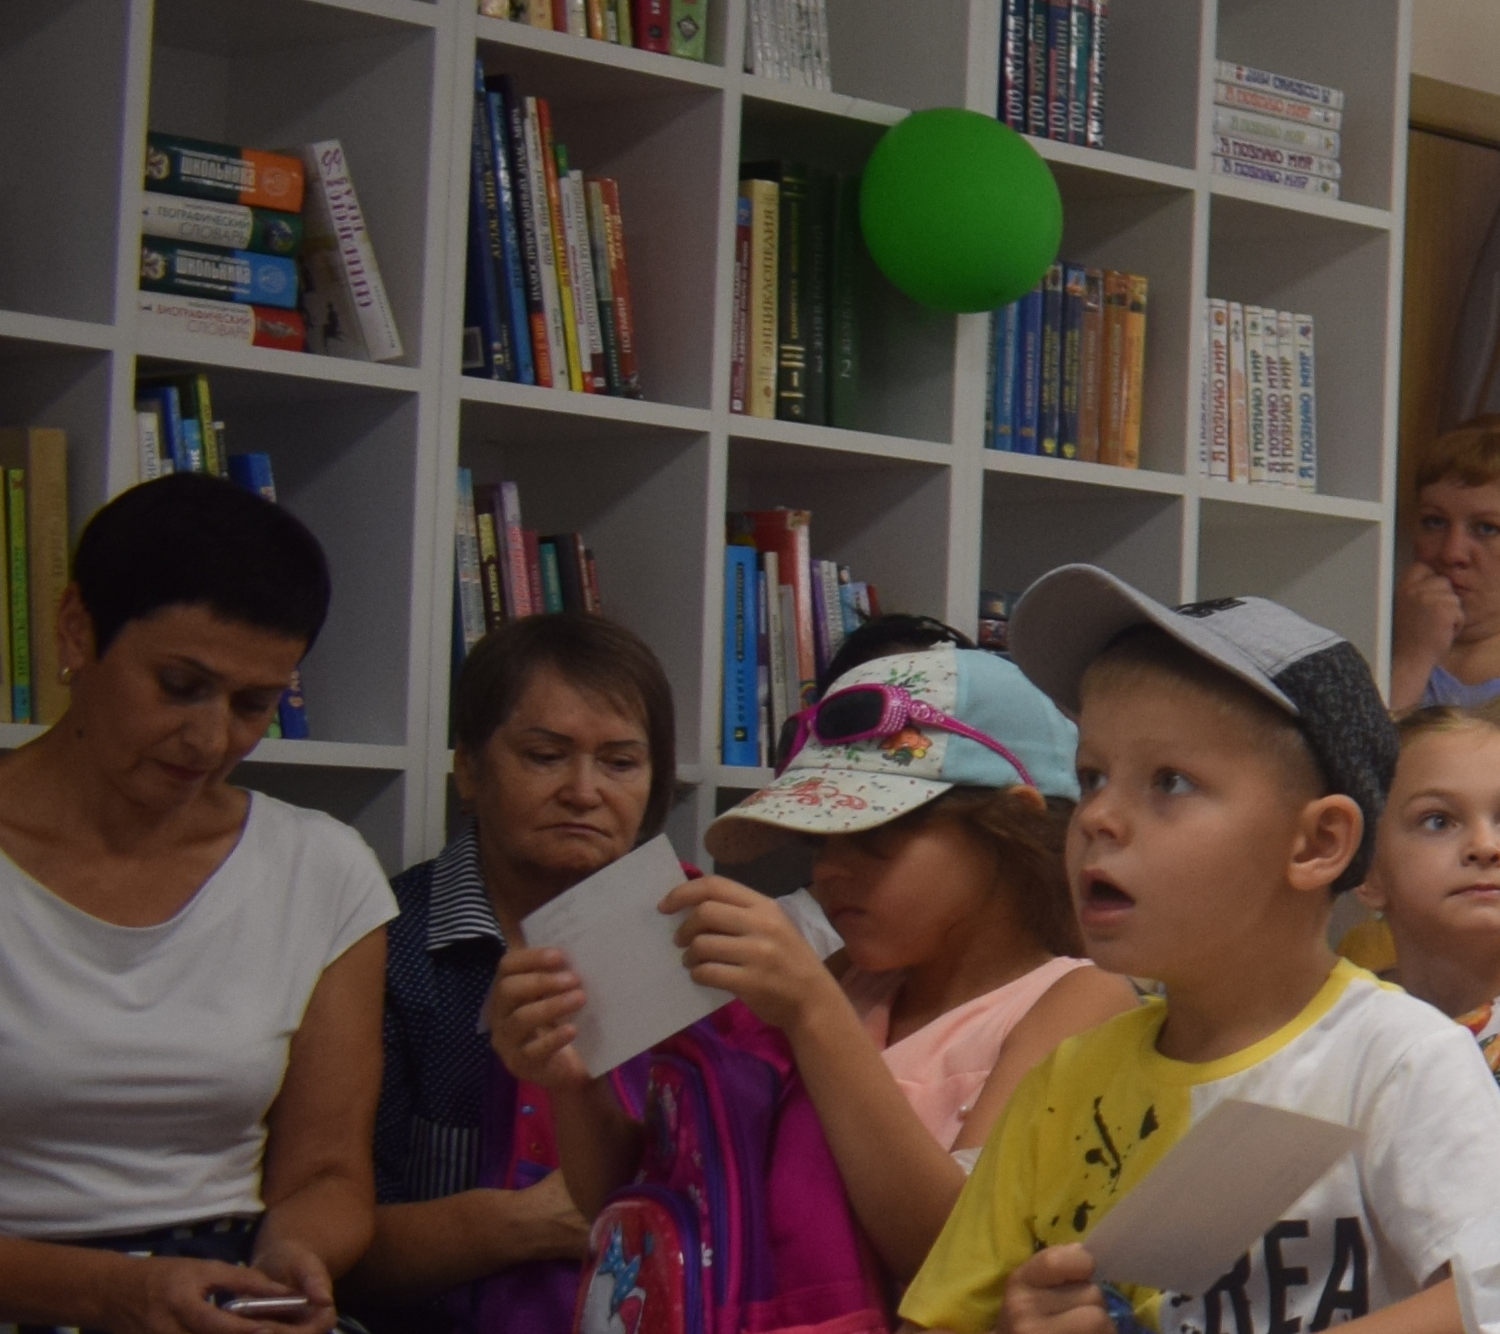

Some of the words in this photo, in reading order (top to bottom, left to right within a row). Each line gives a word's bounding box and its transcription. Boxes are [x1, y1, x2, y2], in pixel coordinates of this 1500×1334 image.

[1007, 89, 1023, 121] 100
[1030, 95, 1046, 126] 100
[1051, 101, 1066, 133] 100
[762, 210, 775, 357] ЭНЦИКЛОПЕДИЯ
[1213, 339, 1226, 370] МИР
[1251, 350, 1263, 383] МИР
[1300, 352, 1311, 388] МИР
[1266, 356, 1278, 389] МИР
[1280, 357, 1293, 390] МИР
[1213, 379, 1226, 446] ПОЗНАЮ
[1252, 388, 1264, 451] ПОЗНАЮ
[1267, 393, 1280, 457] ПОЗНАЮ
[1281, 394, 1294, 457] ПОЗНАЮ
[1300, 393, 1313, 461] ПОЗНАЮ
